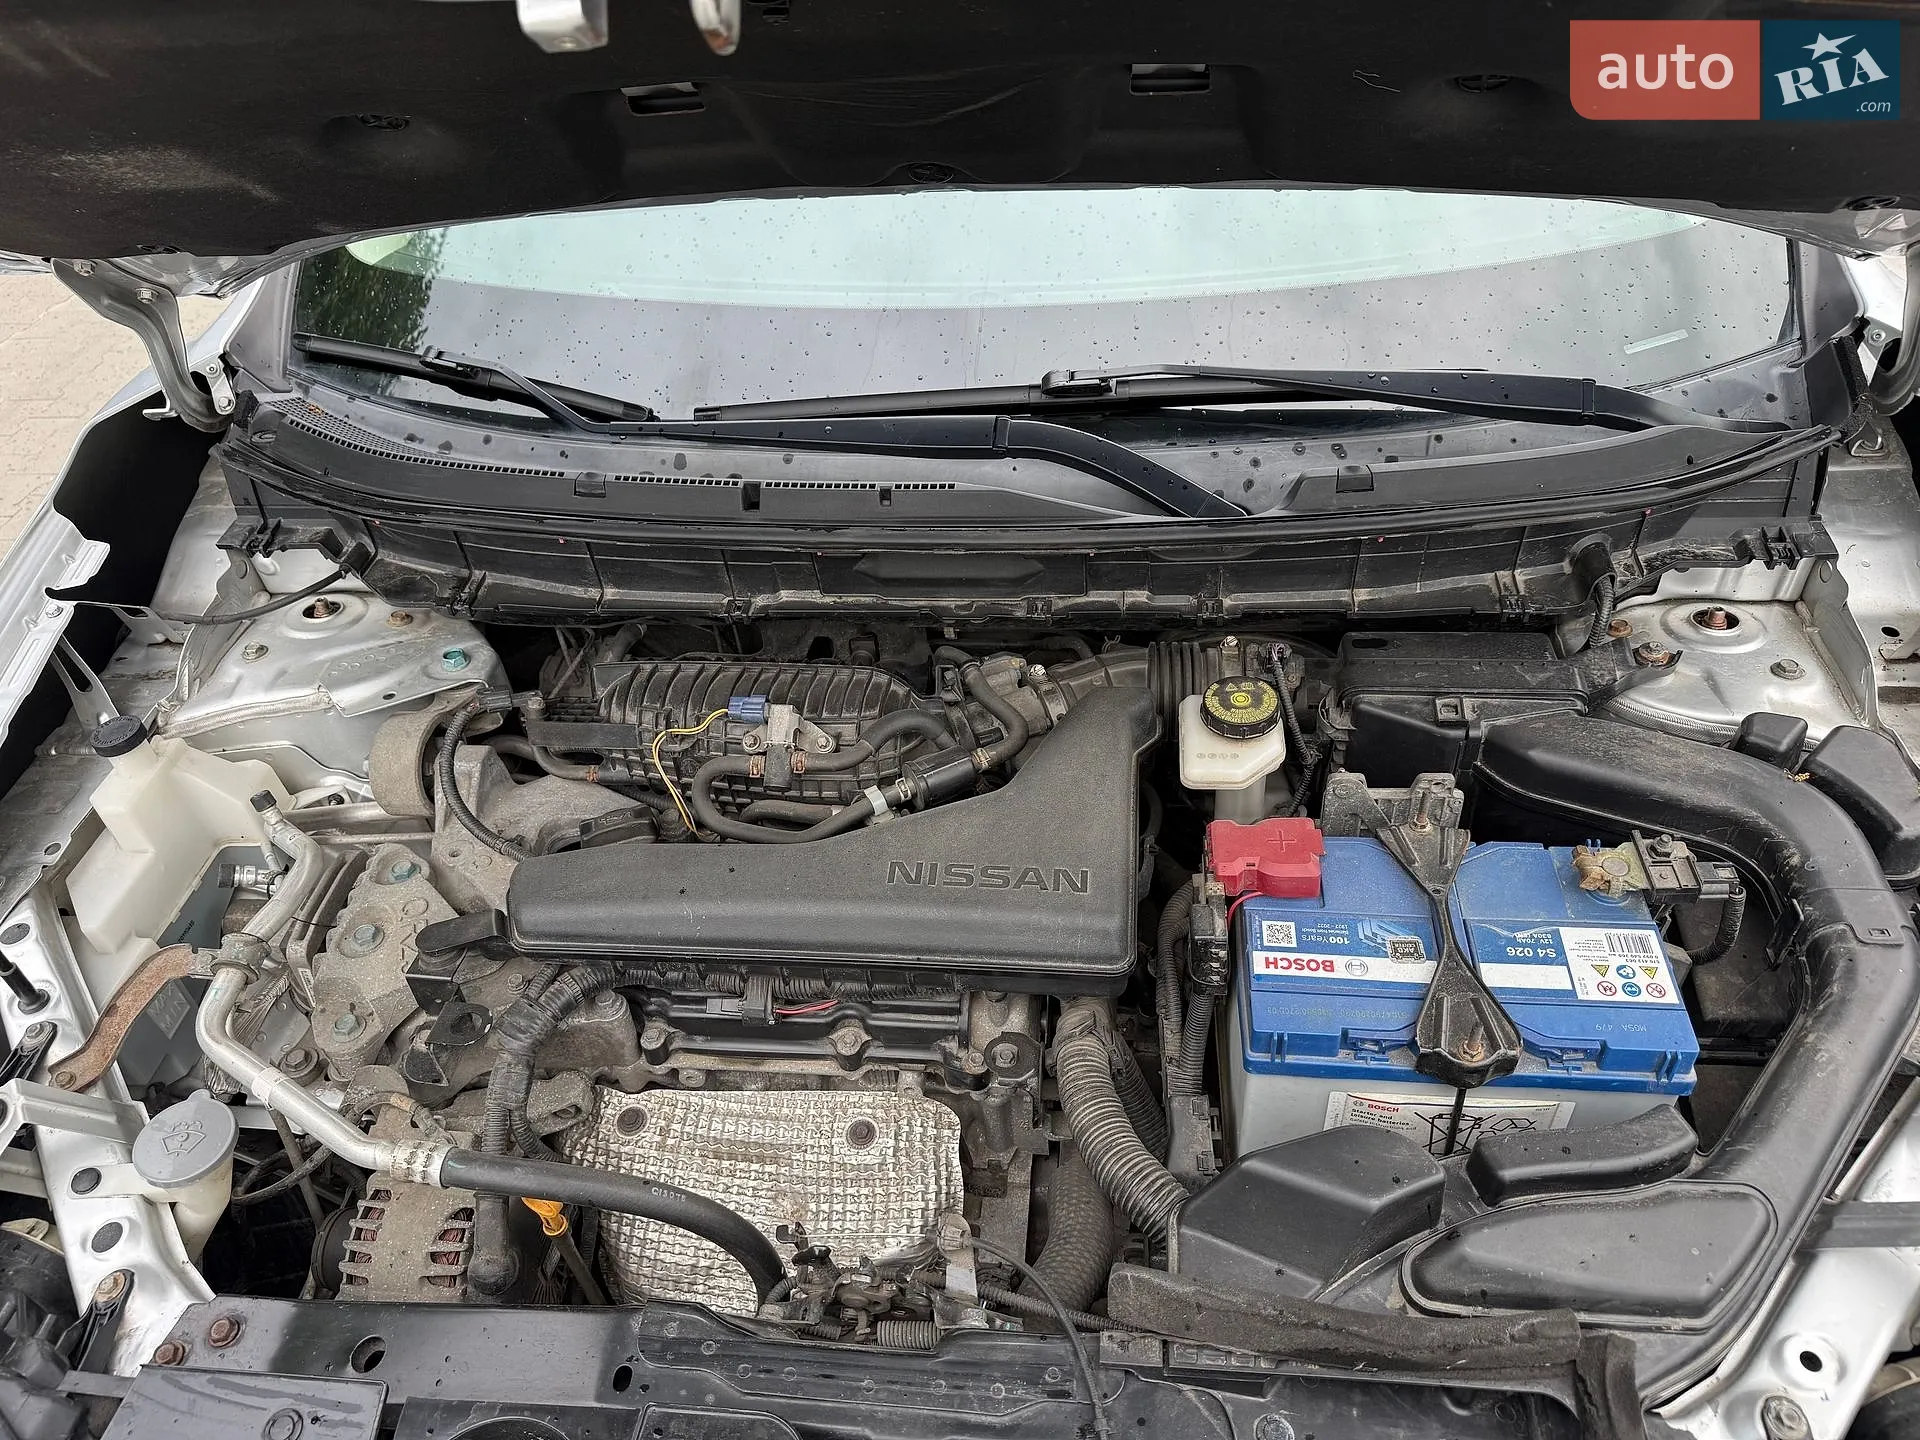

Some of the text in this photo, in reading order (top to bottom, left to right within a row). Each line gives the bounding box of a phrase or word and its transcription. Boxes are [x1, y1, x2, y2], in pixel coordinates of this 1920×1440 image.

[887, 861, 1090, 894] NISSAN
[1301, 934, 1350, 945] 100 Years
[1506, 946, 1533, 957] 026
[1536, 947, 1556, 958] S4
[1264, 956, 1335, 973] BOSCH
[1351, 1108, 1377, 1117] Starter
[1367, 1103, 1400, 1113] BOSCH
